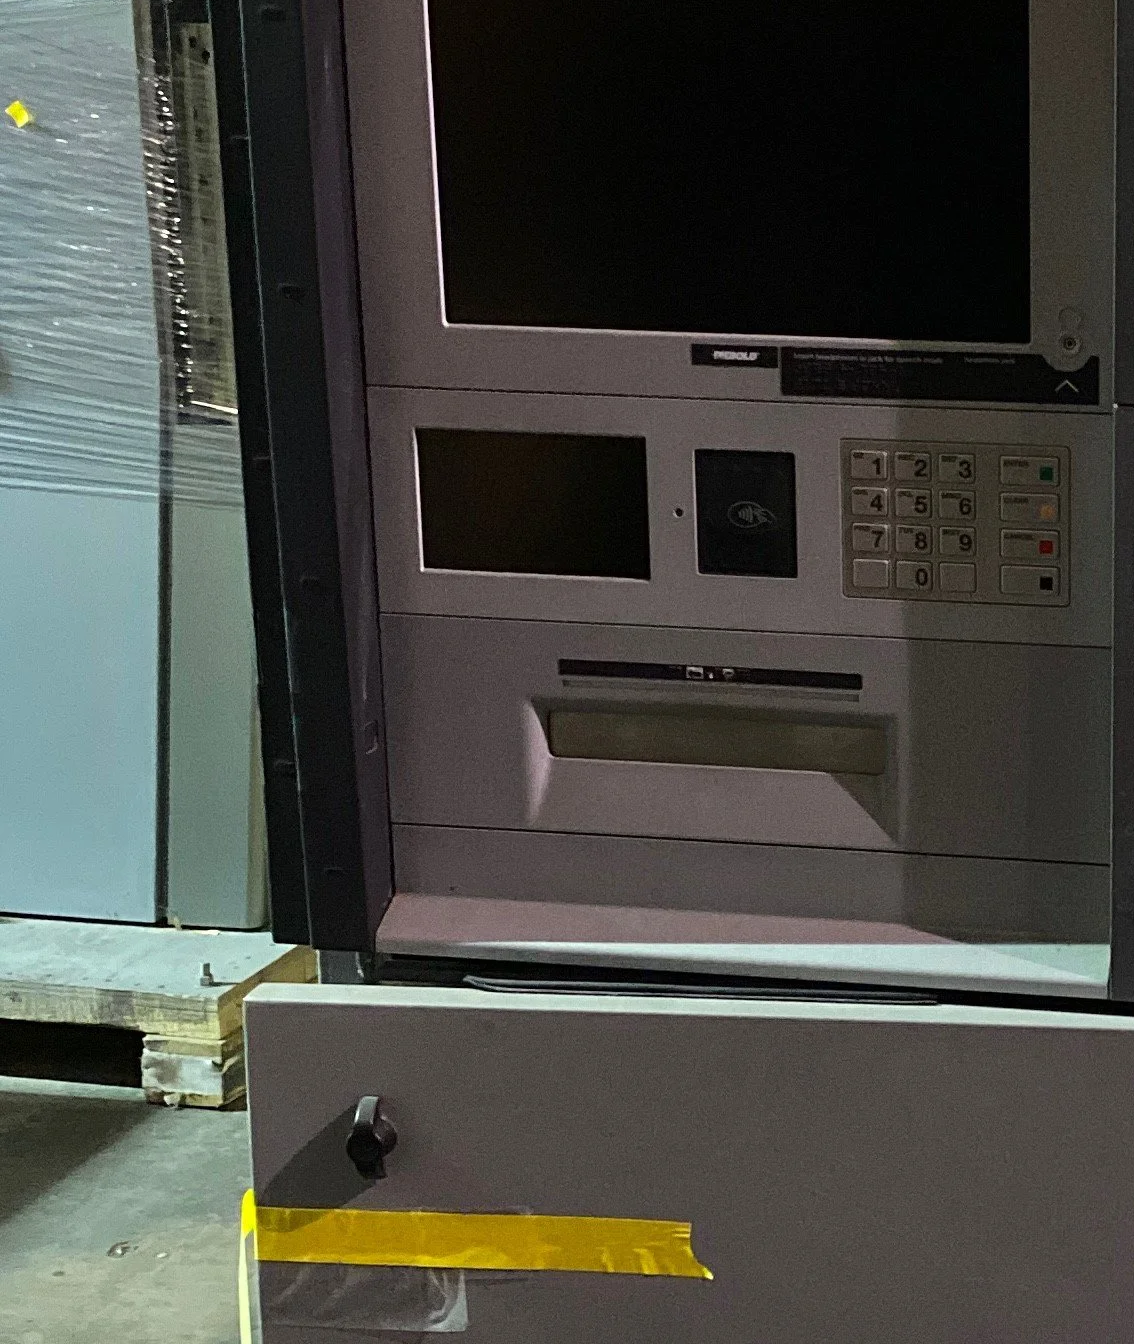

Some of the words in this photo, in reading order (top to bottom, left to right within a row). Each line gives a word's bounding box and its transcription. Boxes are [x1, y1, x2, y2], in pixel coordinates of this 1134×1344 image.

[872, 457, 882, 475] 1
[913, 459, 927, 477] 2
[958, 461, 972, 479] 3
[870, 494, 883, 511] 4
[913, 495, 927, 513] 5
[958, 497, 972, 515] 6
[871, 531, 883, 548] 7
[914, 532, 927, 550] 8
[958, 534, 972, 551] 9
[914, 568, 928, 586] 0
